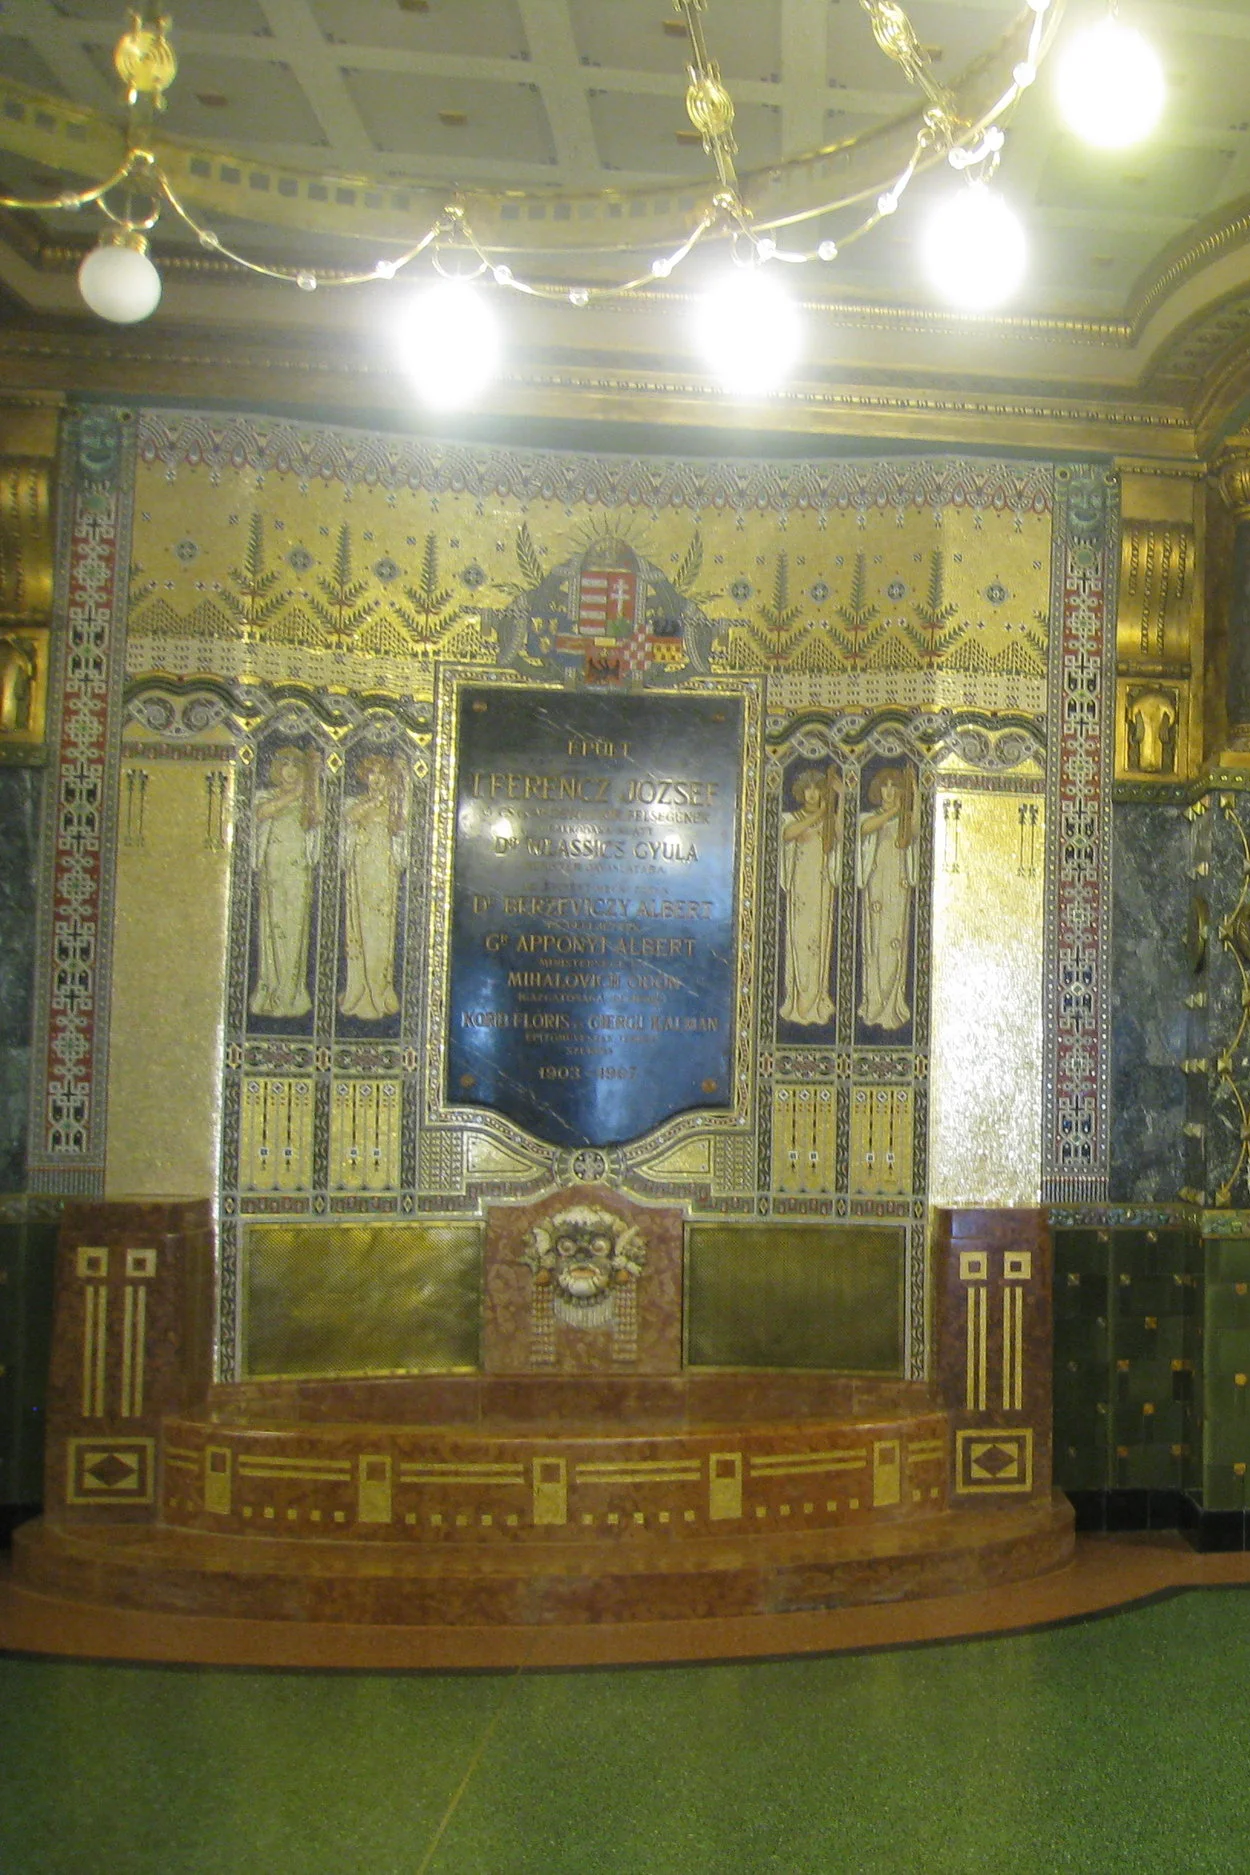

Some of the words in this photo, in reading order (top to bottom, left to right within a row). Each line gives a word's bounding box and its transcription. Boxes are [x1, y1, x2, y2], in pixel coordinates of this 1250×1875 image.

[489, 772, 610, 802] FERENCZ
[632, 841, 698, 863] GYULA
[636, 900, 714, 919] ALBERT
[516, 935, 606, 953] APPONYI
[616, 937, 696, 957] ALBERT
